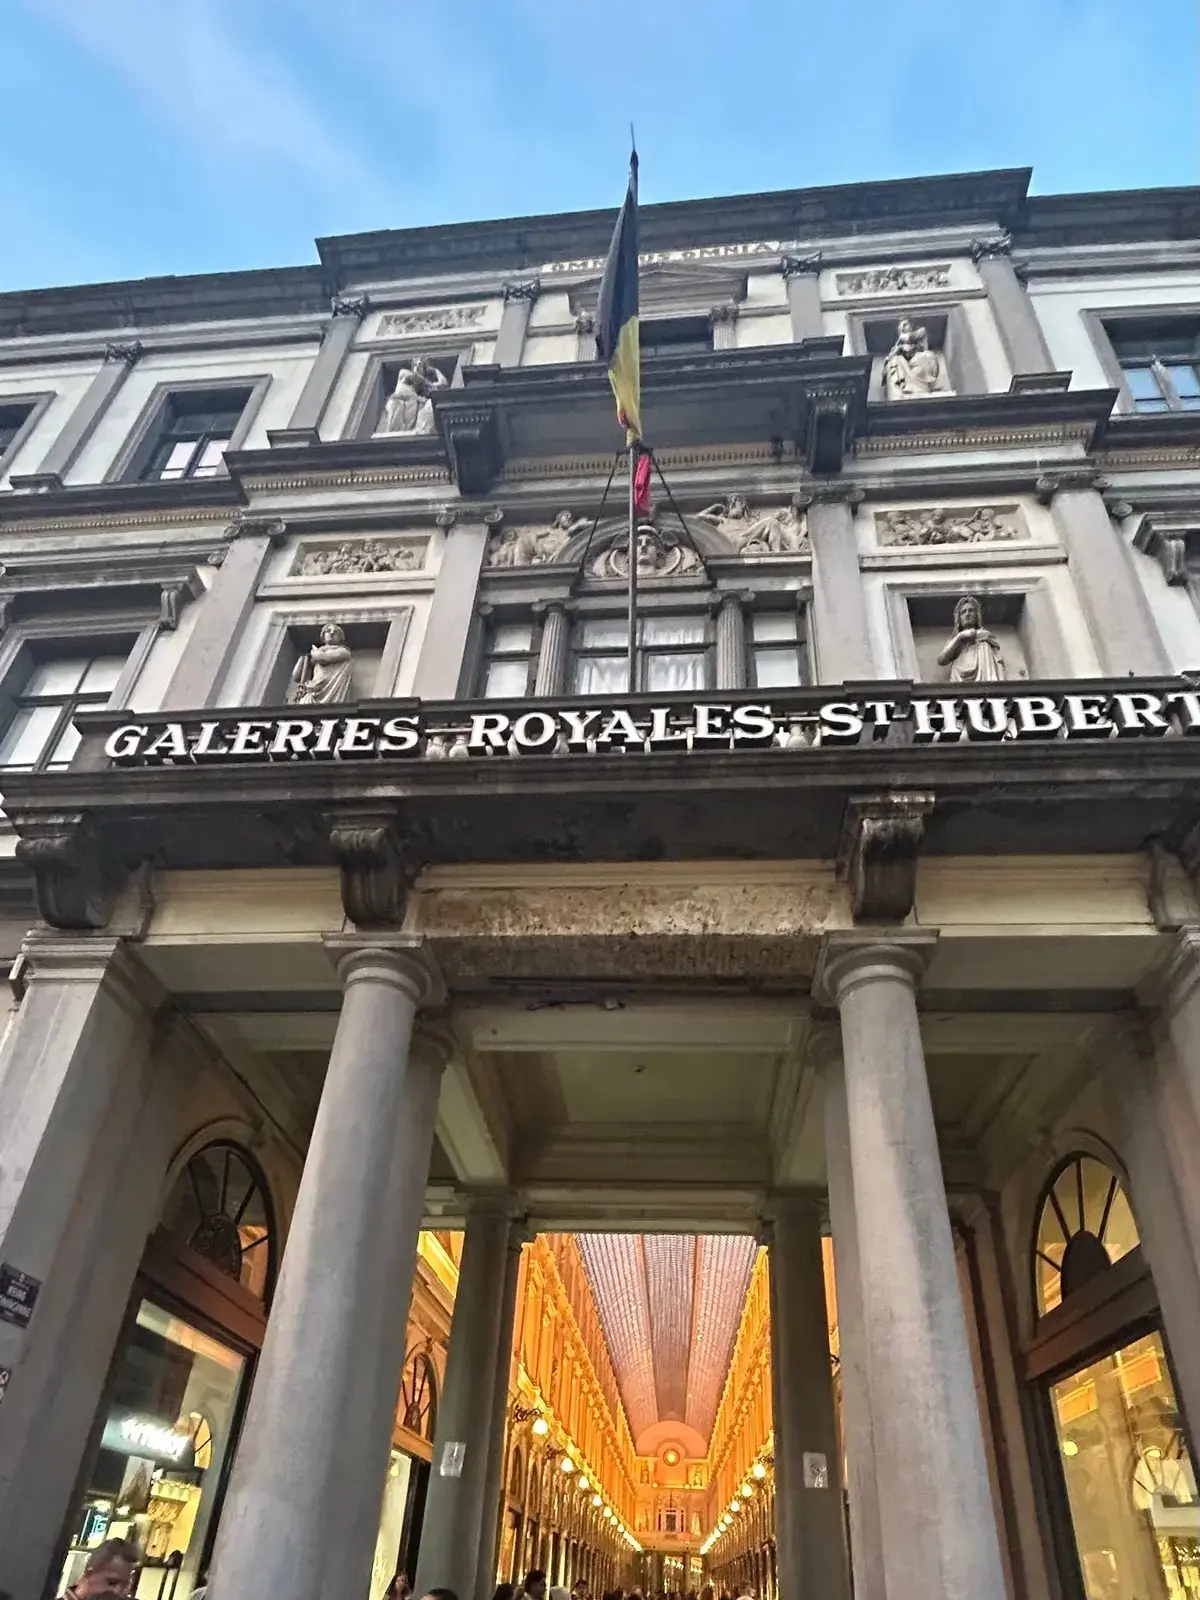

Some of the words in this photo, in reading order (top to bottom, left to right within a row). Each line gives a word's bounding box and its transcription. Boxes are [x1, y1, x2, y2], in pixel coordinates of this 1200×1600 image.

[681, 243, 774, 260] OMNIA
[105, 716, 419, 758] GALERIES
[468, 704, 775, 751] ROYALES
[910, 692, 1200, 734] HUBERT
